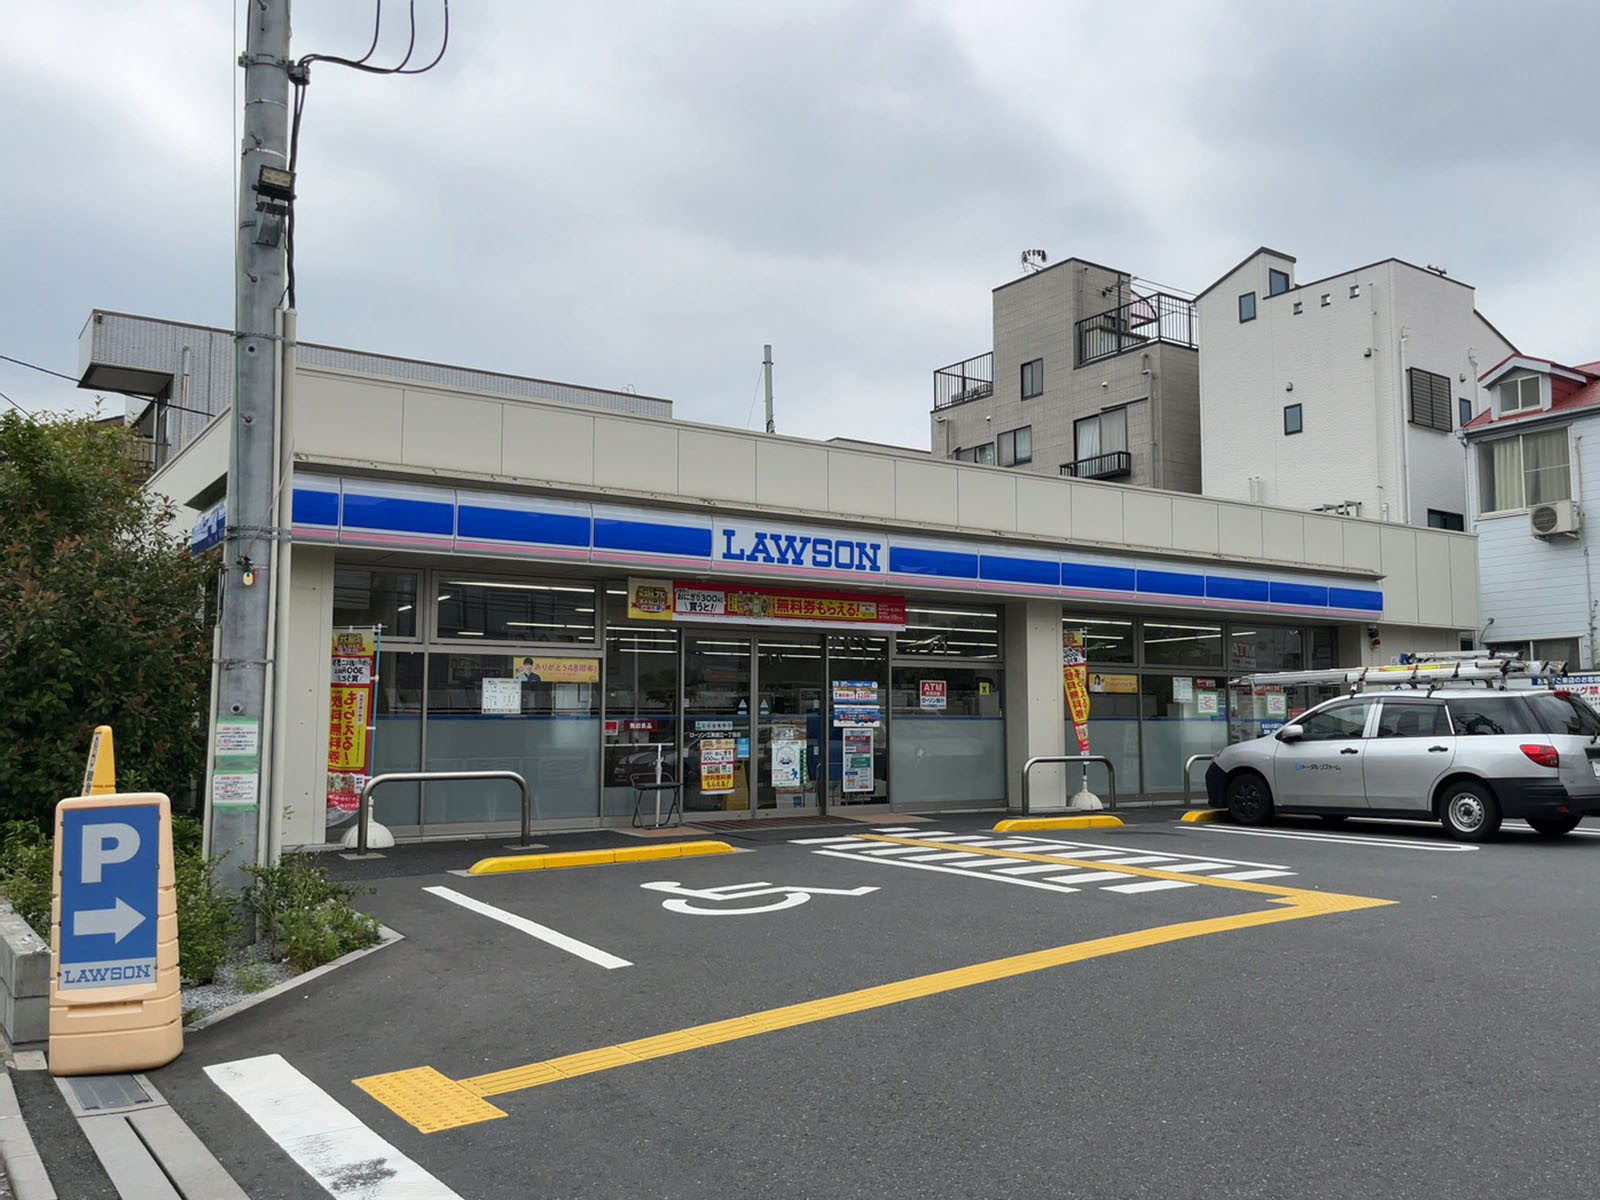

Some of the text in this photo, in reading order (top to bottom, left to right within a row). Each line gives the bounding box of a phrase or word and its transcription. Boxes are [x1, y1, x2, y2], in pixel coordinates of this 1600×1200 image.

[722, 529, 881, 572] LAWSON
[924, 683, 943, 692] ATM
[81, 822, 141, 884] P
[63, 963, 151, 985] LAWSON
